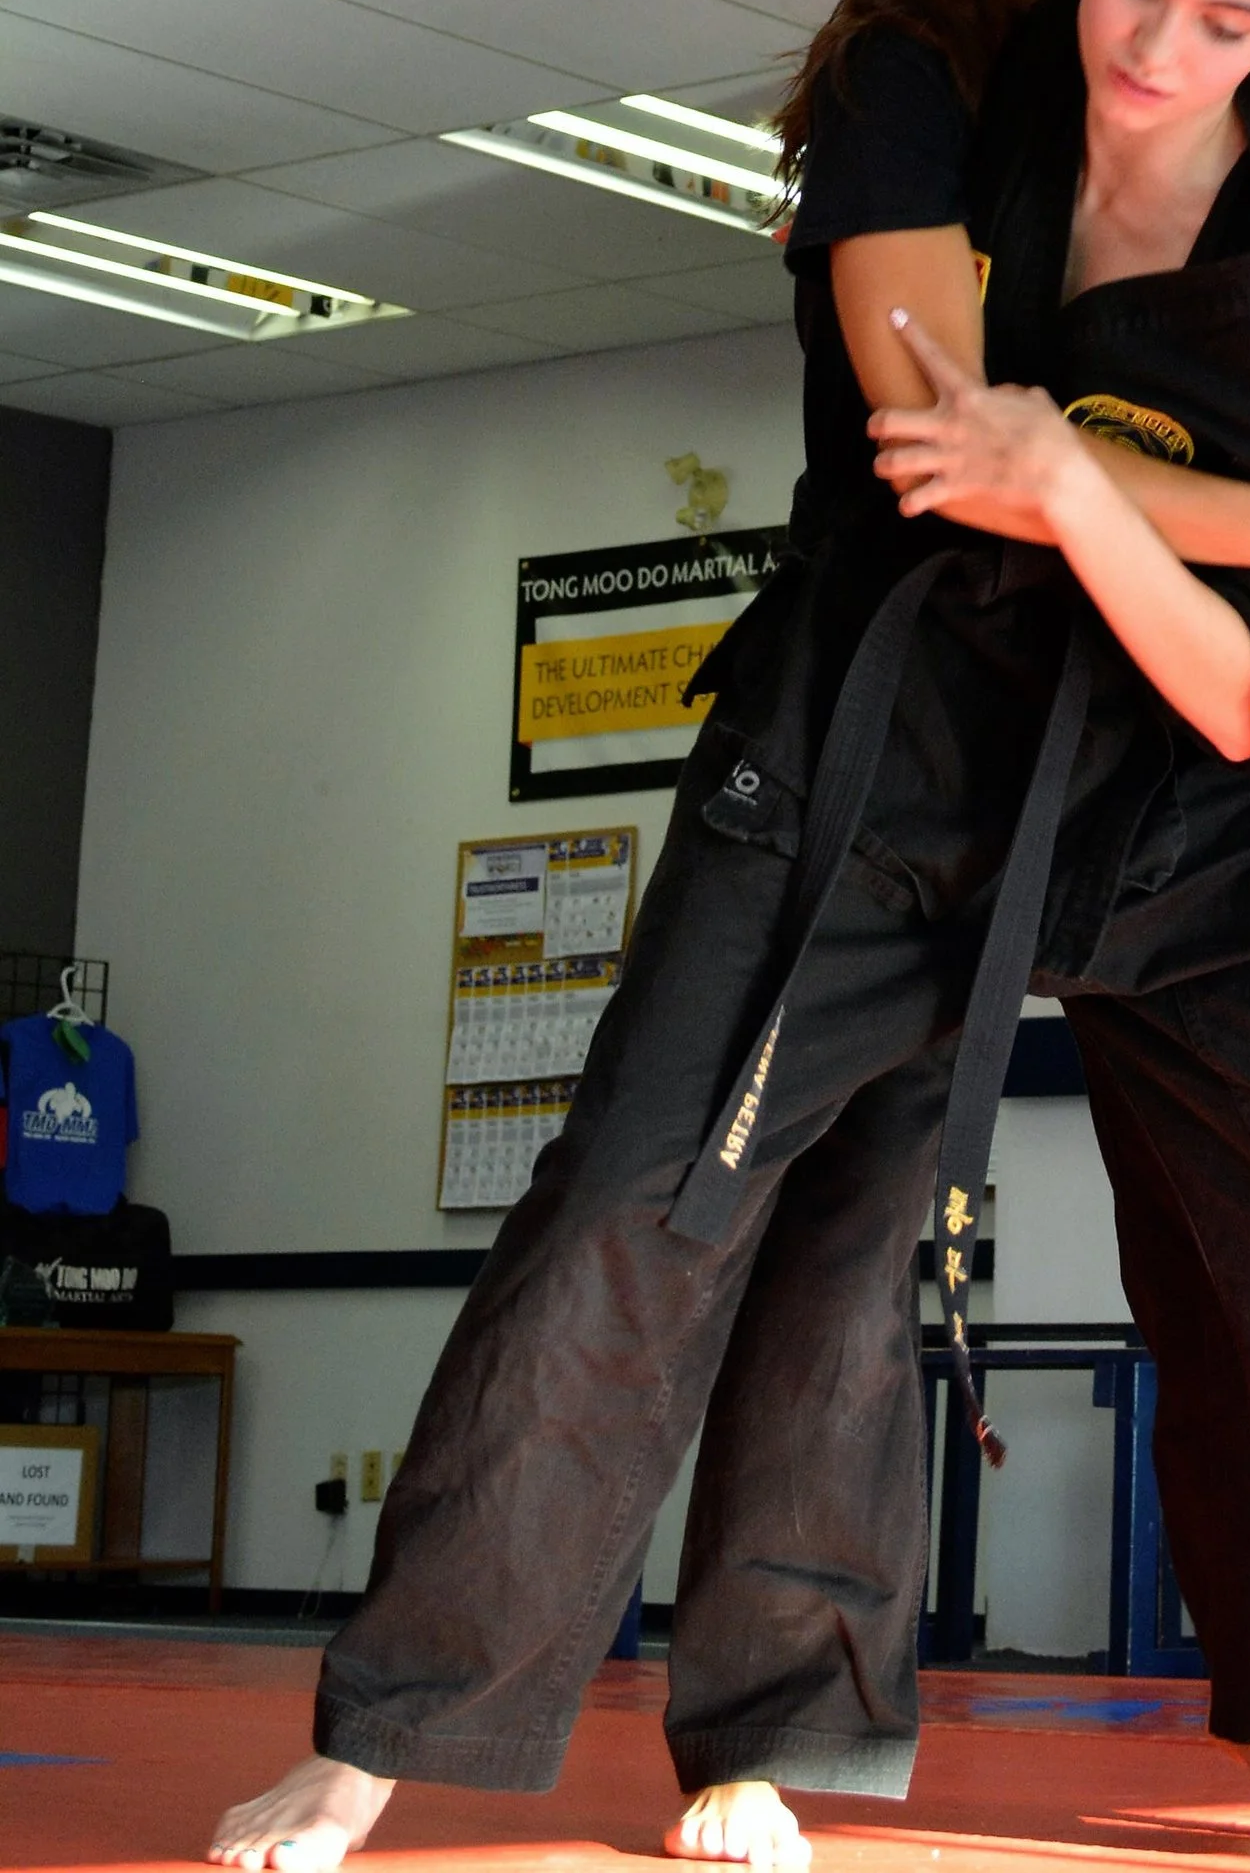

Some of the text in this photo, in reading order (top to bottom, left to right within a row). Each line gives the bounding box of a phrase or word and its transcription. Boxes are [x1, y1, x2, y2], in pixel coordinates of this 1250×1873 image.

[521, 551, 780, 603] TONG MOO DO MARTIAL A
[535, 657, 567, 684] THE
[571, 647, 669, 679] ULTIMATE
[532, 683, 670, 720] DEVELOPMENT
[54, 1290, 105, 1302] MARTIAL
[22, 1465, 51, 1479] LOST
[0, 1492, 69, 1507] AND FOUND
